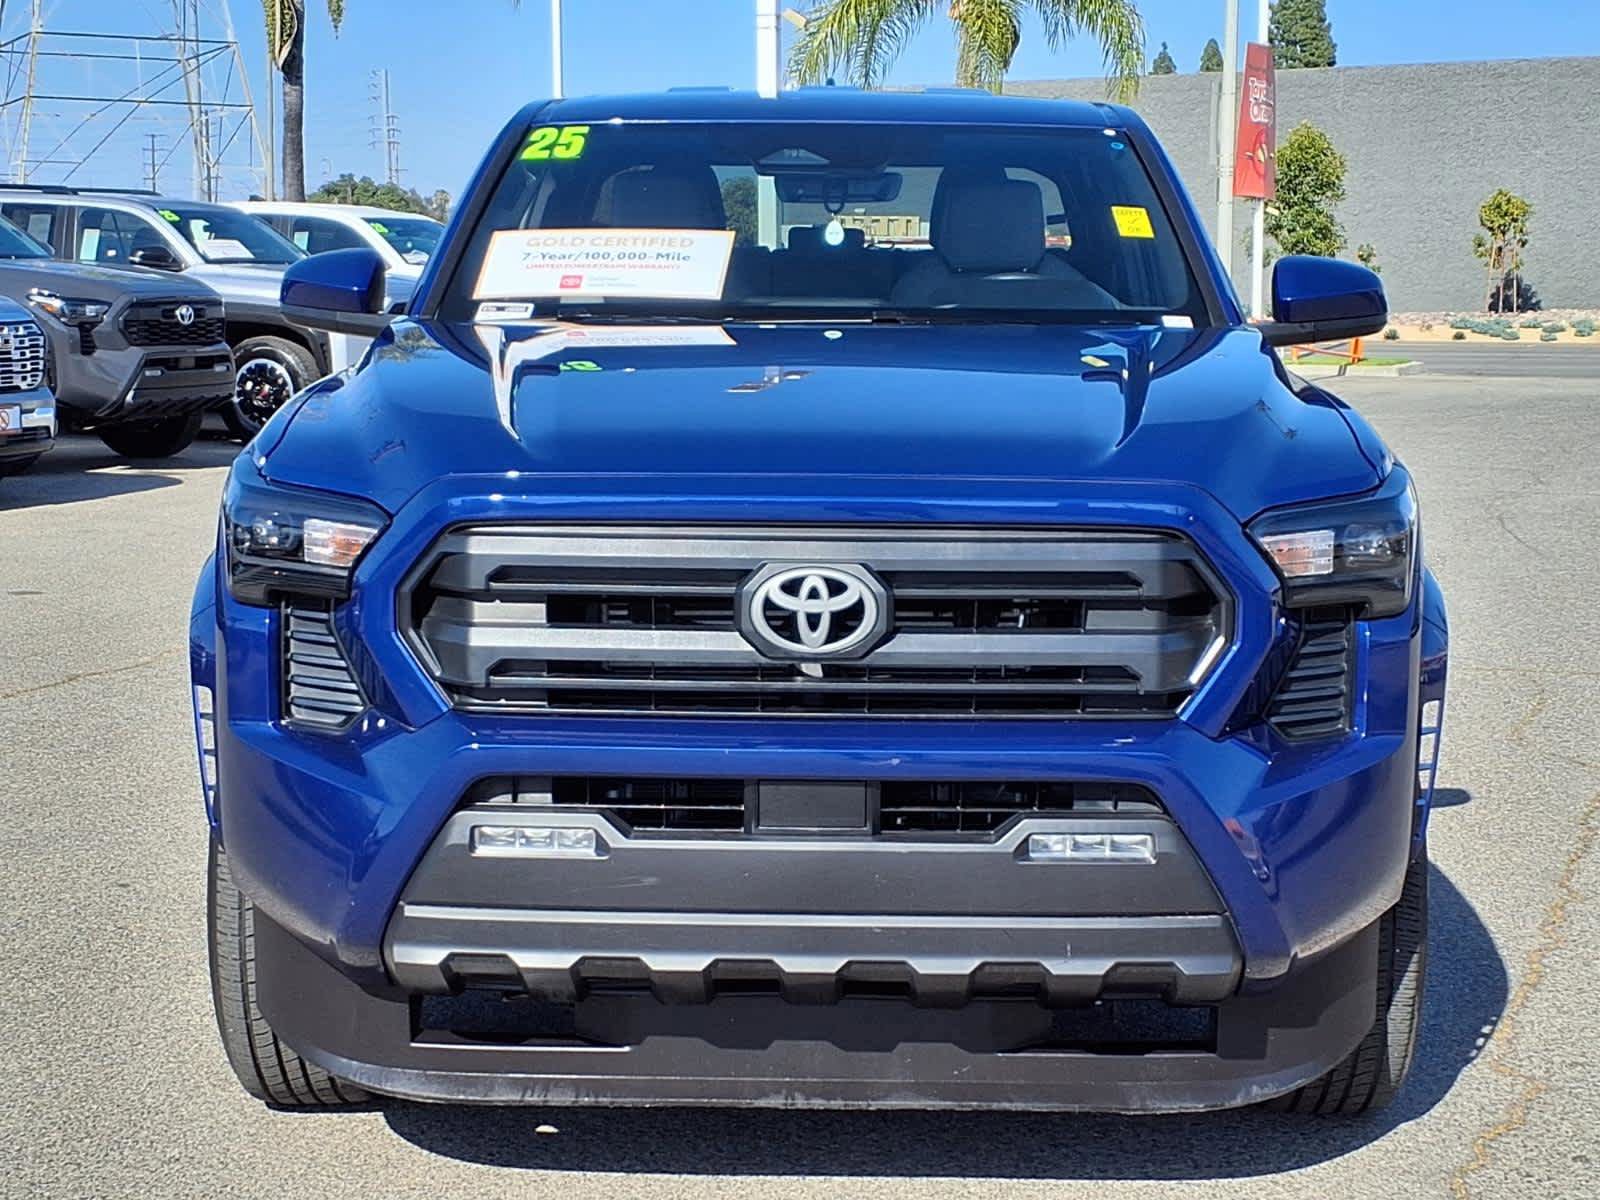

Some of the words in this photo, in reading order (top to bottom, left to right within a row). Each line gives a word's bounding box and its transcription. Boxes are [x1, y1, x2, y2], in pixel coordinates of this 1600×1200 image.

[519, 126, 590, 160] 25
[526, 236, 585, 248] GOLD
[589, 236, 695, 248] CERTIFIED
